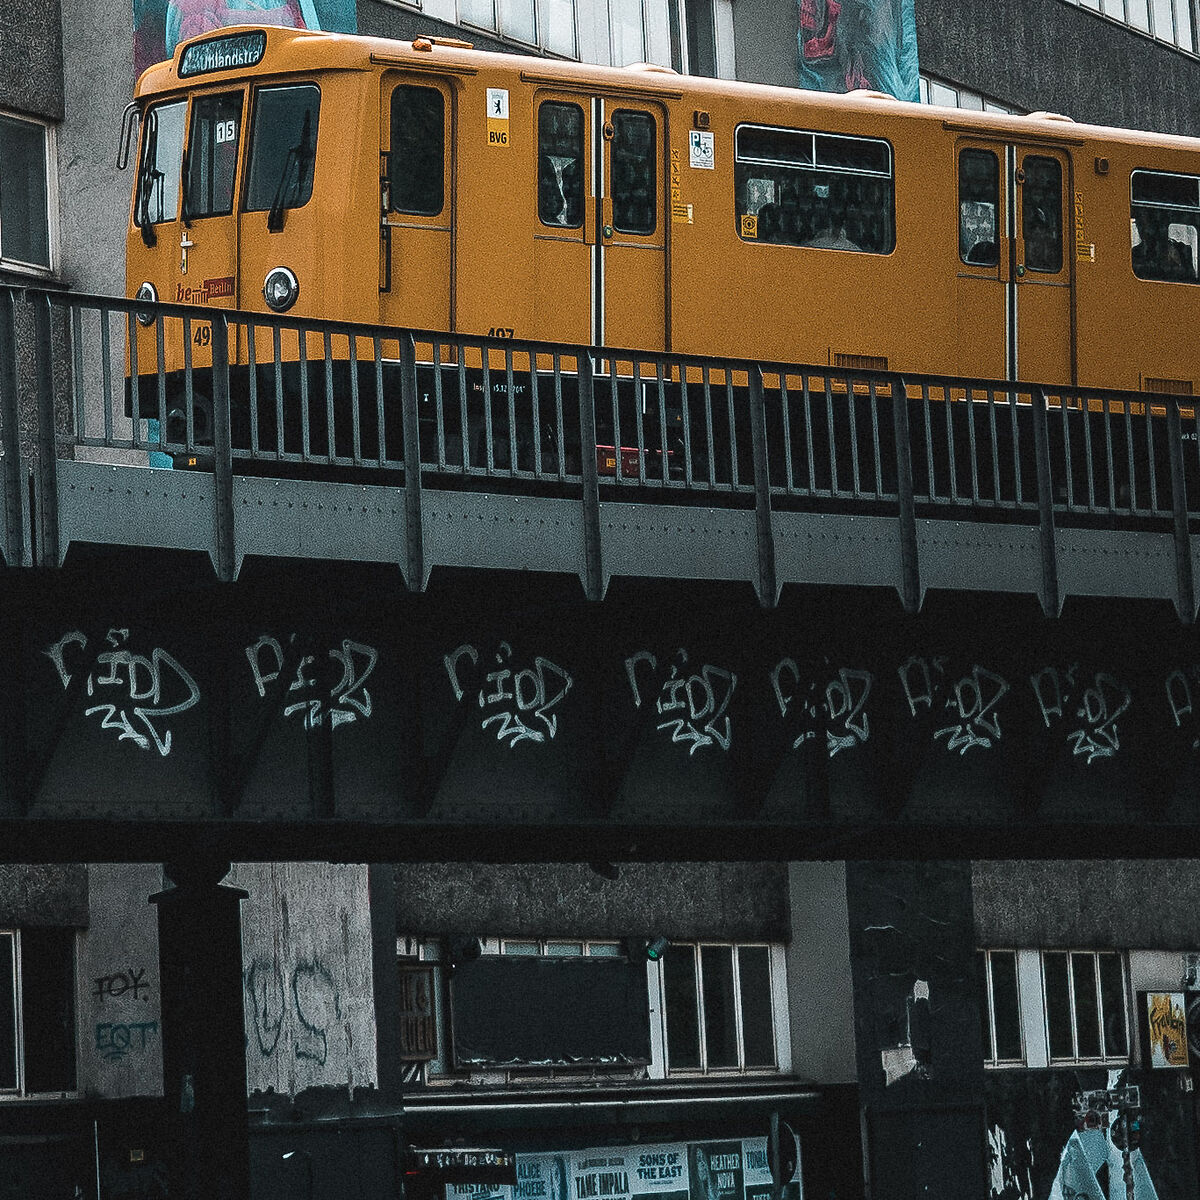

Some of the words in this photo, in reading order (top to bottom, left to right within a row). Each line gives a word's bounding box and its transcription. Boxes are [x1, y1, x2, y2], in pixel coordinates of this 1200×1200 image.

[489, 131, 508, 144] BVG
[193, 325, 211, 347] 49
[710, 1153, 741, 1171] HEATHER
[636, 1167, 657, 1180] THE
[658, 1165, 683, 1179] EAST
